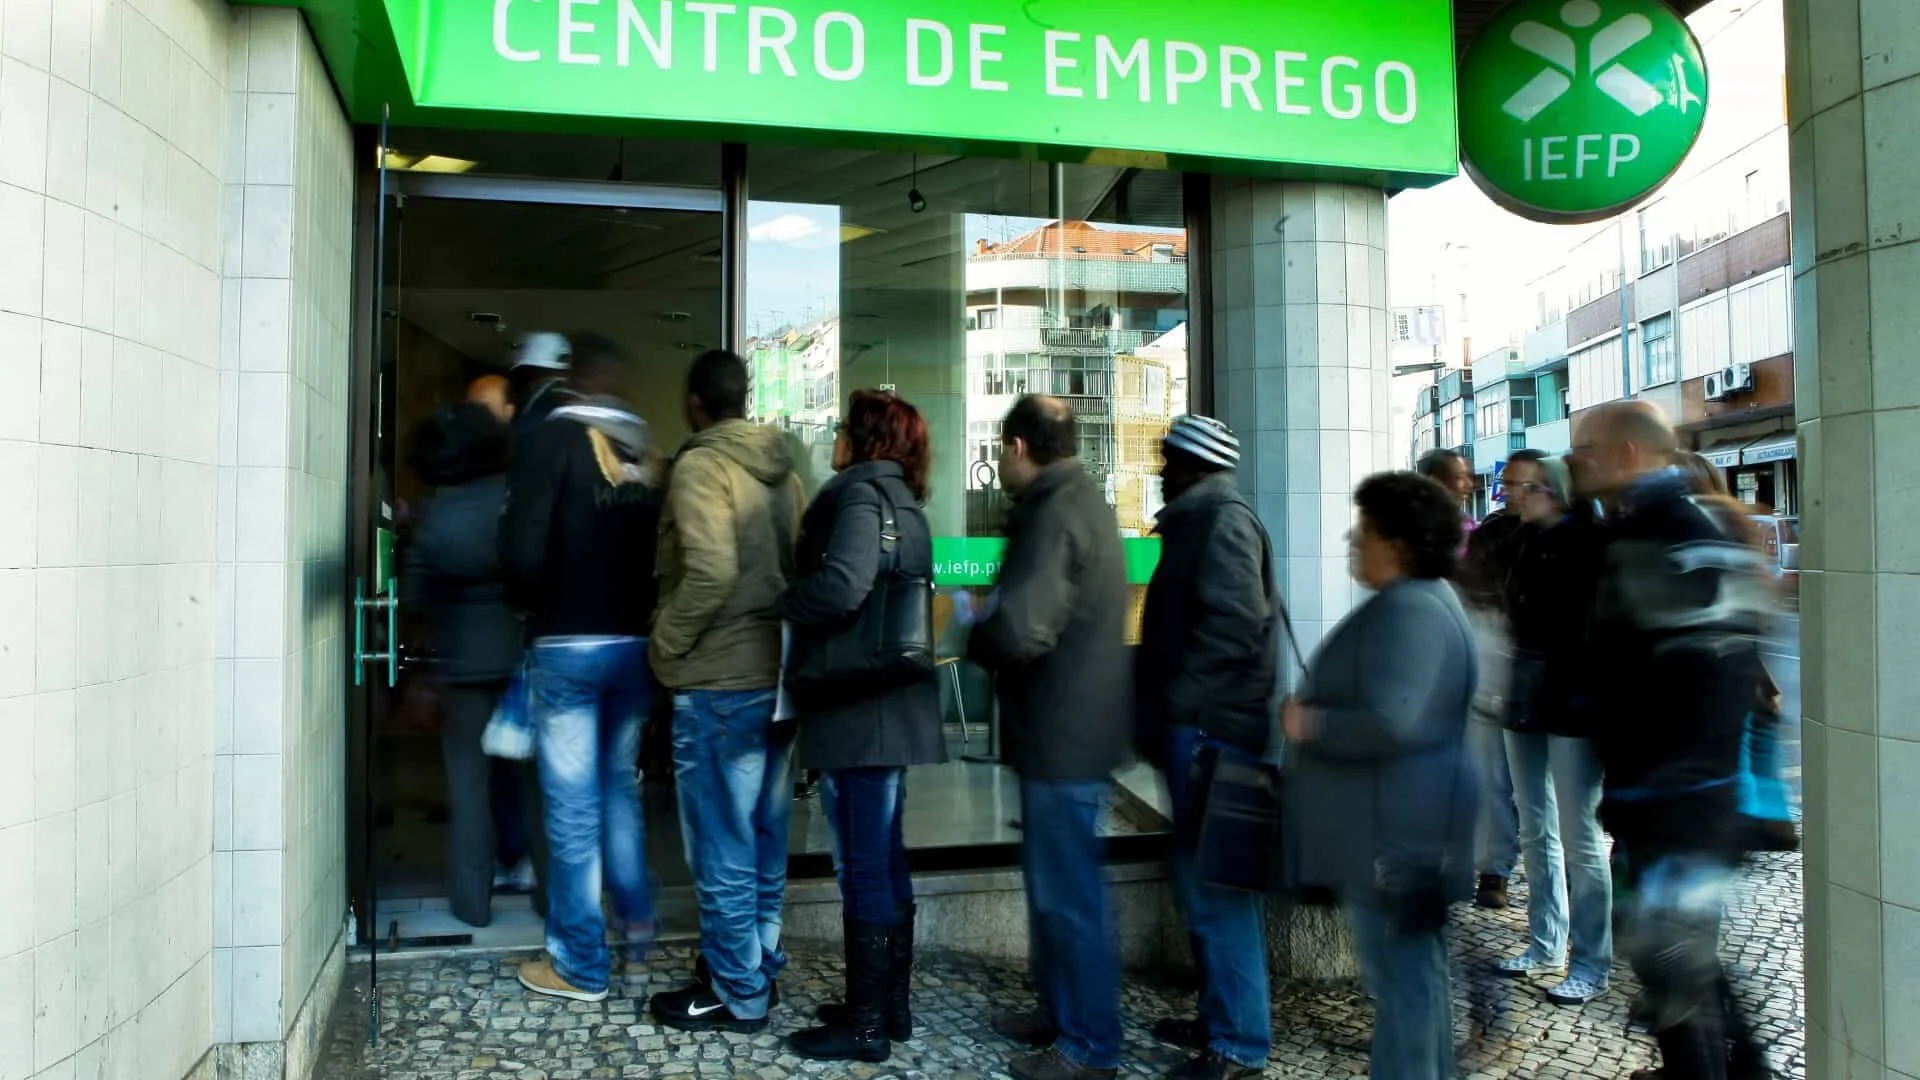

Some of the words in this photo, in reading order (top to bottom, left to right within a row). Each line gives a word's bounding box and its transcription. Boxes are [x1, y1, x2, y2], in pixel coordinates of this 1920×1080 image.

[493, 0, 865, 81] CENTRO
[906, 18, 1009, 91] DE
[1044, 30, 1417, 124] EMPREGO
[1523, 133, 1641, 181] IEFP
